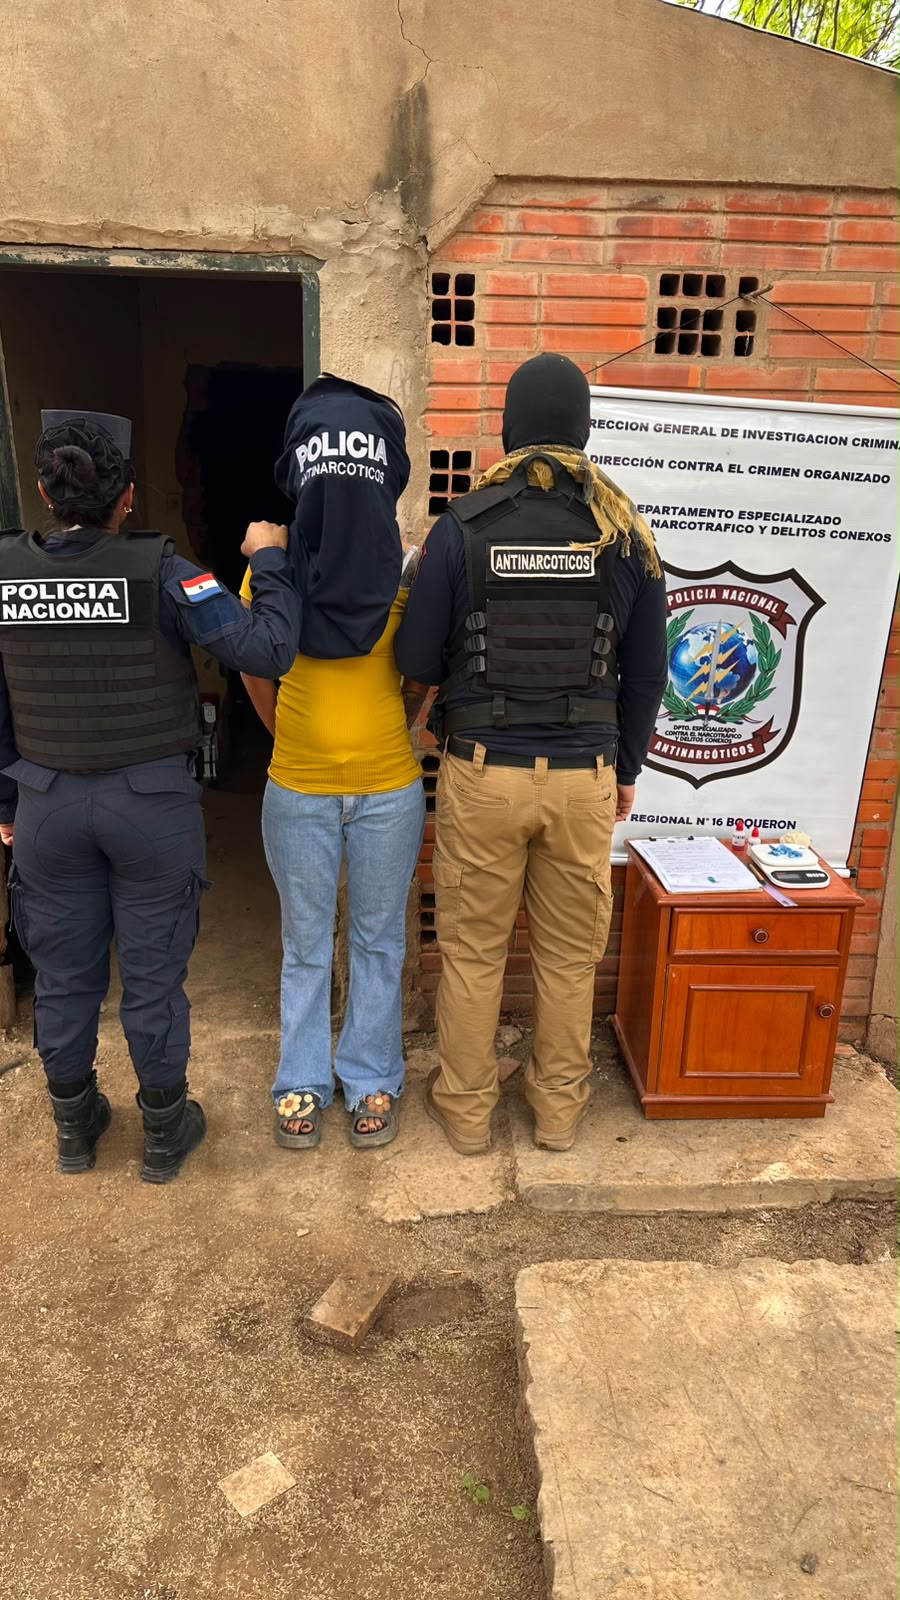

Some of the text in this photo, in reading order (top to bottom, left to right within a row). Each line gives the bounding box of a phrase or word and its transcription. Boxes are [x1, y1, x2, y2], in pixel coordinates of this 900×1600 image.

[590, 418, 900, 450] RECCION GENERAL DE INVESTIGACION CRIMIN
[295, 430, 388, 473] POLICIA
[300, 461, 385, 487] ANTINARCOTICOS
[590, 454, 891, 484] DIRECCIÓN CONTRA EL CRIMEN ORGANIZADO
[637, 504, 842, 526] EPARTAMENTO ESPECIALIZADO
[651, 519, 892, 543] NARCOTRAFICO Y DELITOS CONEXOS
[495, 553, 590, 570] ANTINARCOTICOS
[1, 583, 120, 601] POLICIA
[667, 588, 779, 614] POLICIA NACIONAL
[2, 602, 122, 620] NACIONAL
[692, 725, 737, 733] ESPECIALIZADO
[653, 743, 755, 760] ANTINARCÓTICOS
[630, 813, 693, 825] REGIONAL
[711, 817, 723, 826] 16
[726, 817, 797, 830] BOQUERON
